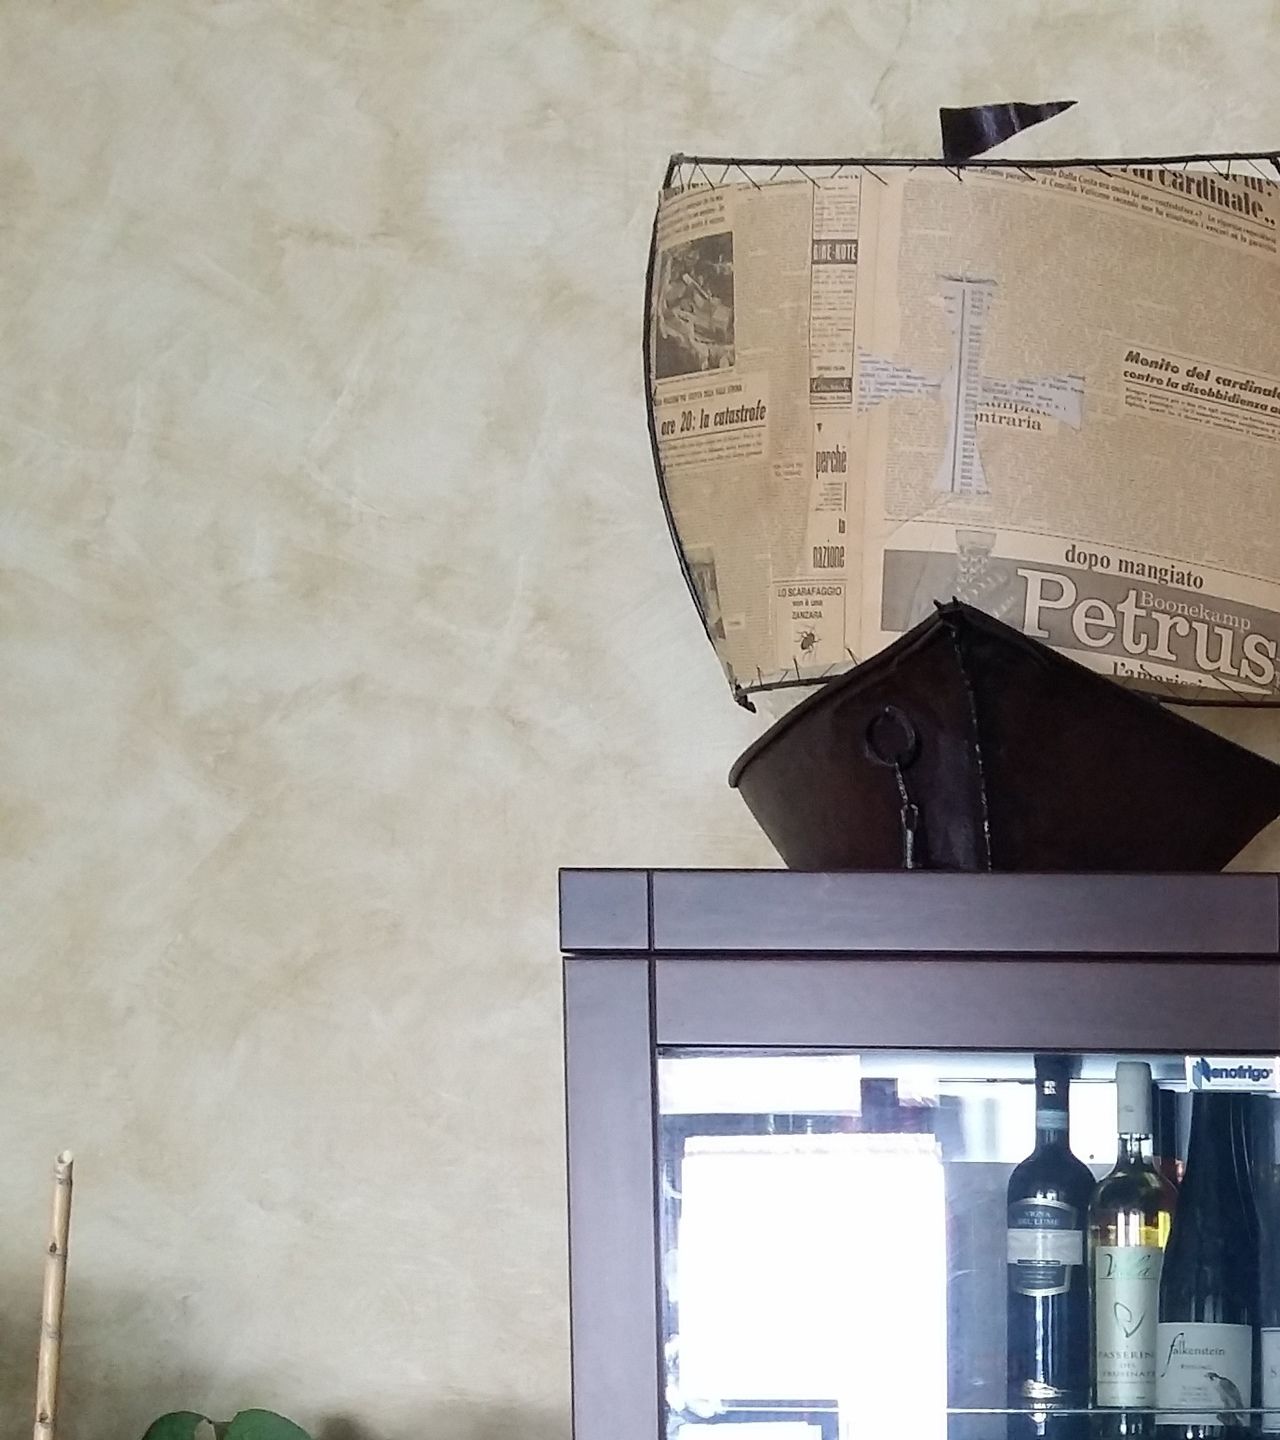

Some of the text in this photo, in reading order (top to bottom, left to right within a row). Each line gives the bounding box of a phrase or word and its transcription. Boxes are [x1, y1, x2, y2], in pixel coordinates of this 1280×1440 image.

[1124, 350, 1180, 374] Monito
[1186, 366, 1210, 382] del
[1123, 369, 1164, 387] contro
[1166, 376, 1180, 390] la
[1181, 379, 1267, 413] disobbidienza
[713, 400, 767, 427] catastrofe
[1065, 544, 1204, 590] dopo mangiato
[1017, 568, 1278, 686] Petrus
[1139, 590, 1251, 634] Boonekamp
[1211, 1065, 1270, 1082] enofrigo
[1161, 1332, 1225, 1378] falkenstein
